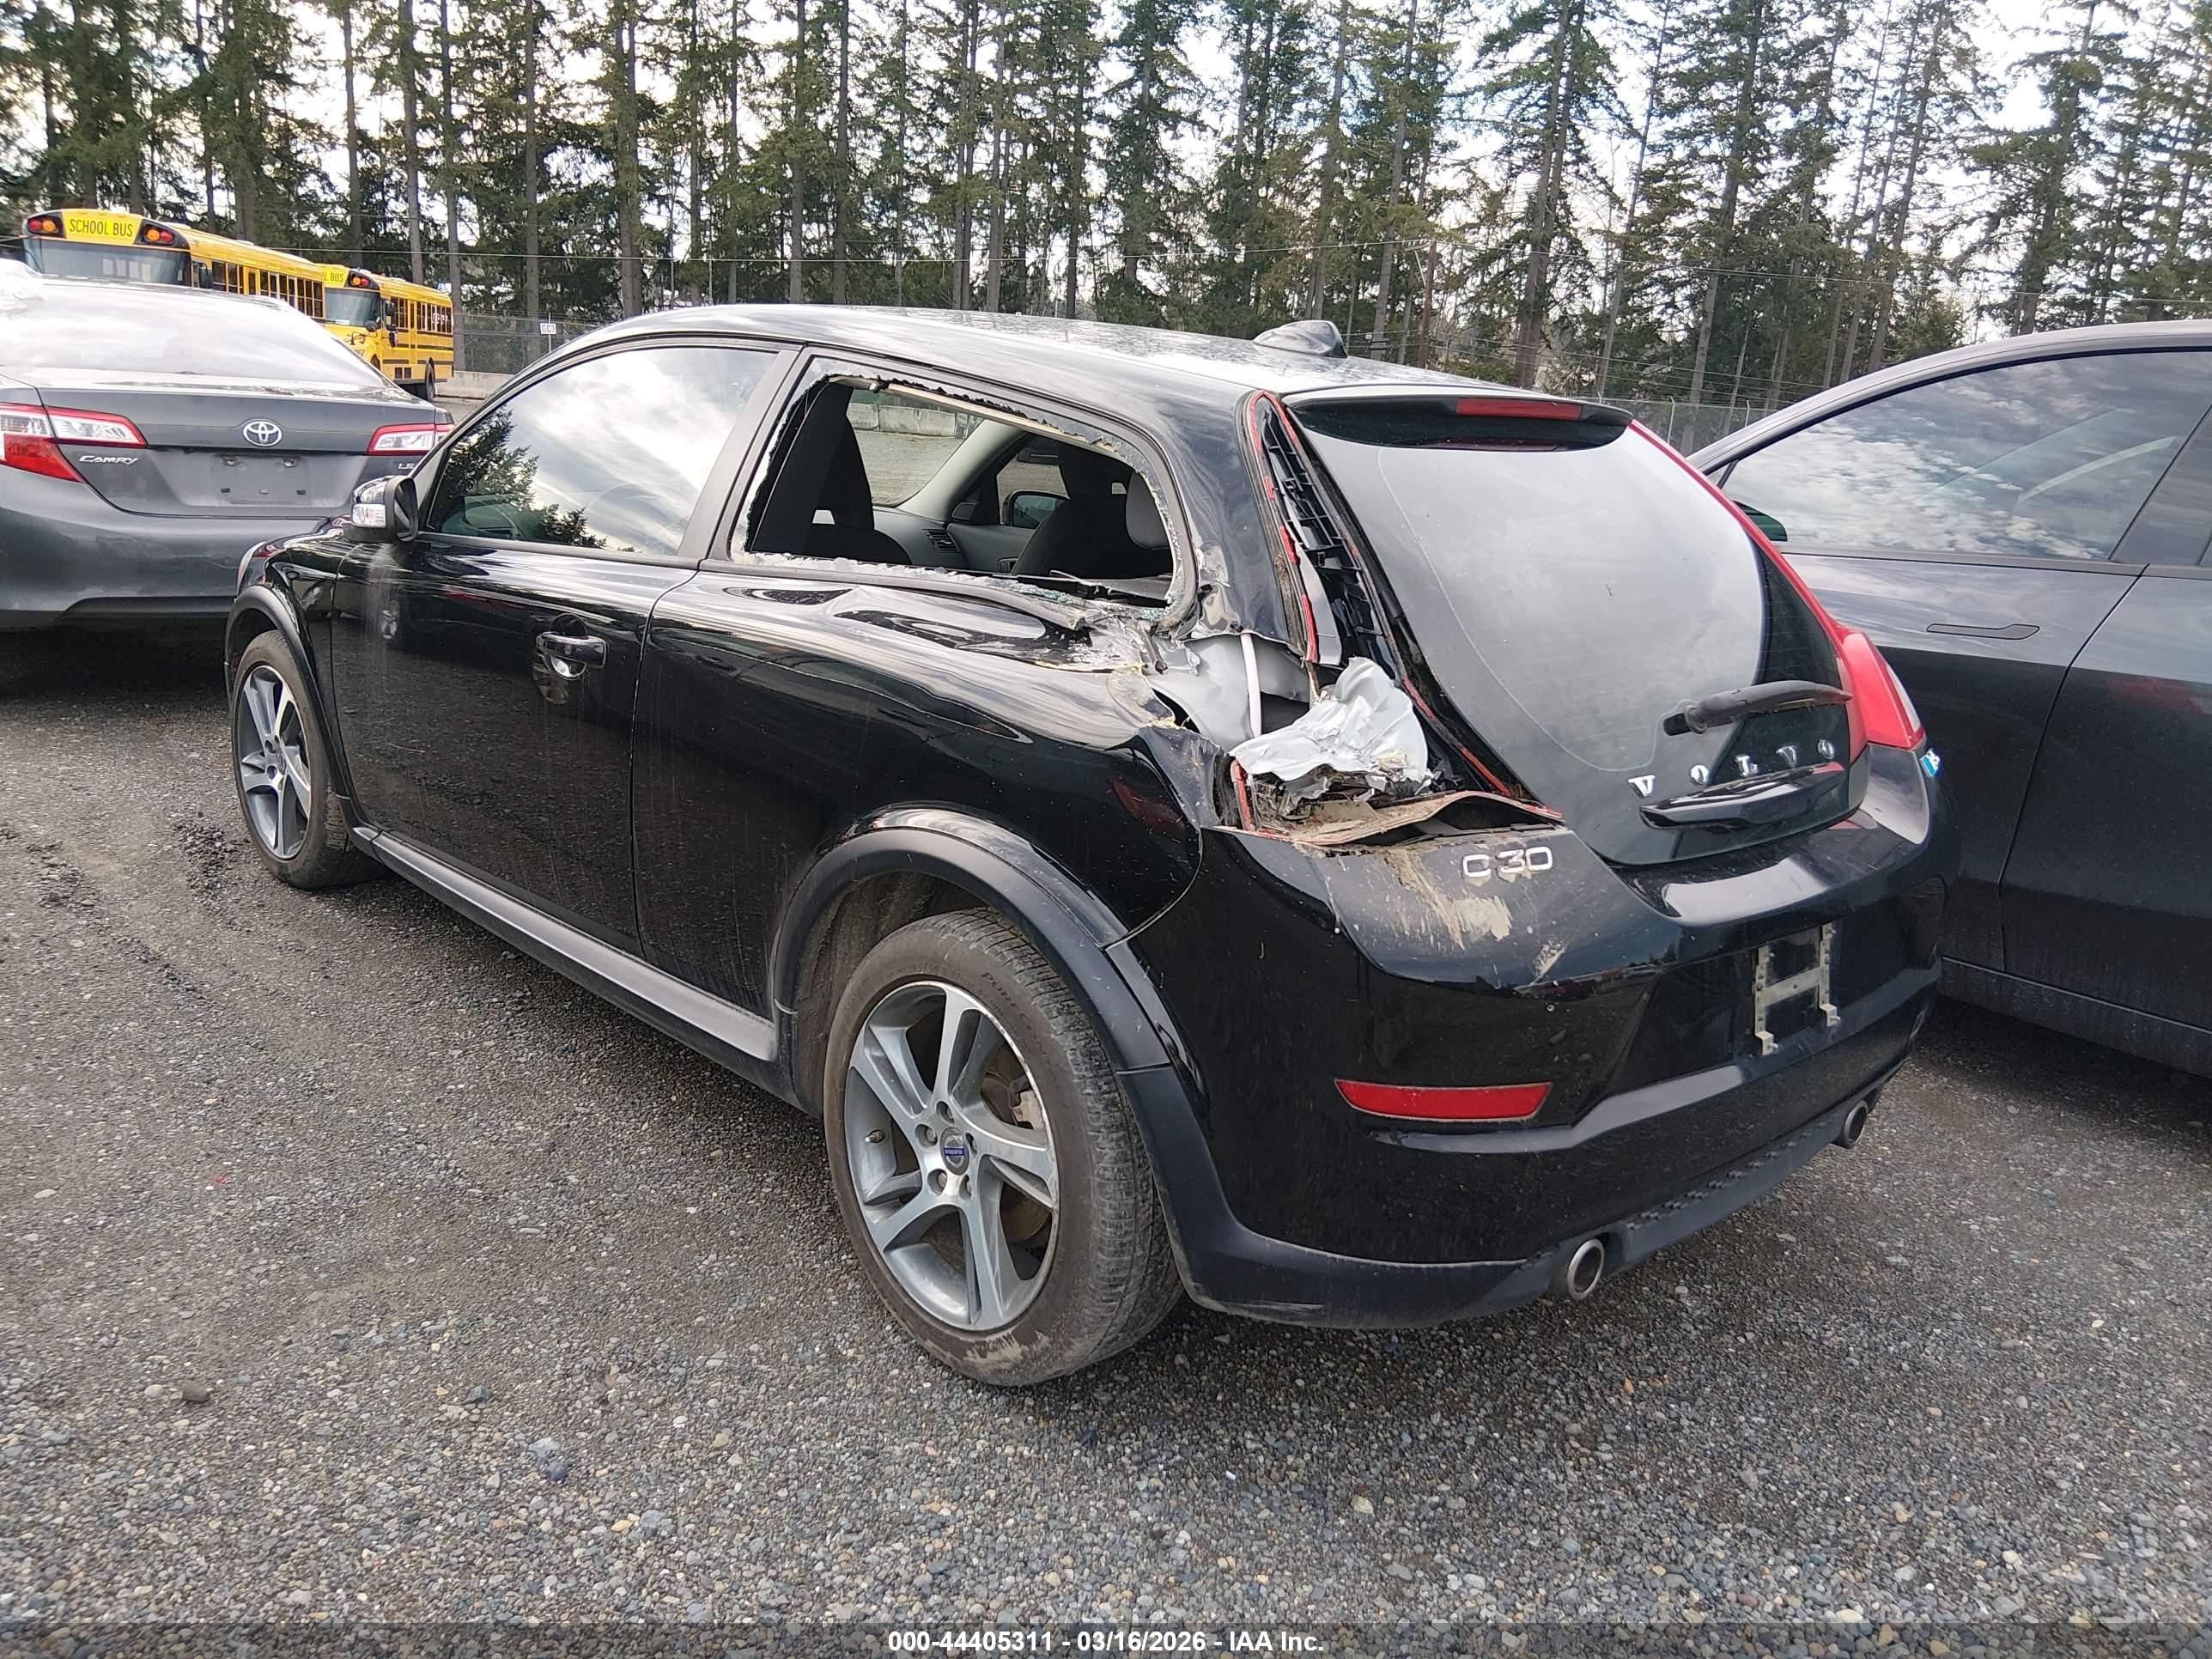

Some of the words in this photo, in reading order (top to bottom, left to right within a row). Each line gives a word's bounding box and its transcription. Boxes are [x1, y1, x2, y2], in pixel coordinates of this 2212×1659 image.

[70, 219, 109, 234] SCHOOL
[113, 222, 133, 237] BUS
[331, 272, 344, 283] BUS
[79, 455, 139, 465] CAMRY
[1628, 738, 1835, 798] VOLVO
[1462, 846, 1553, 878] C30
